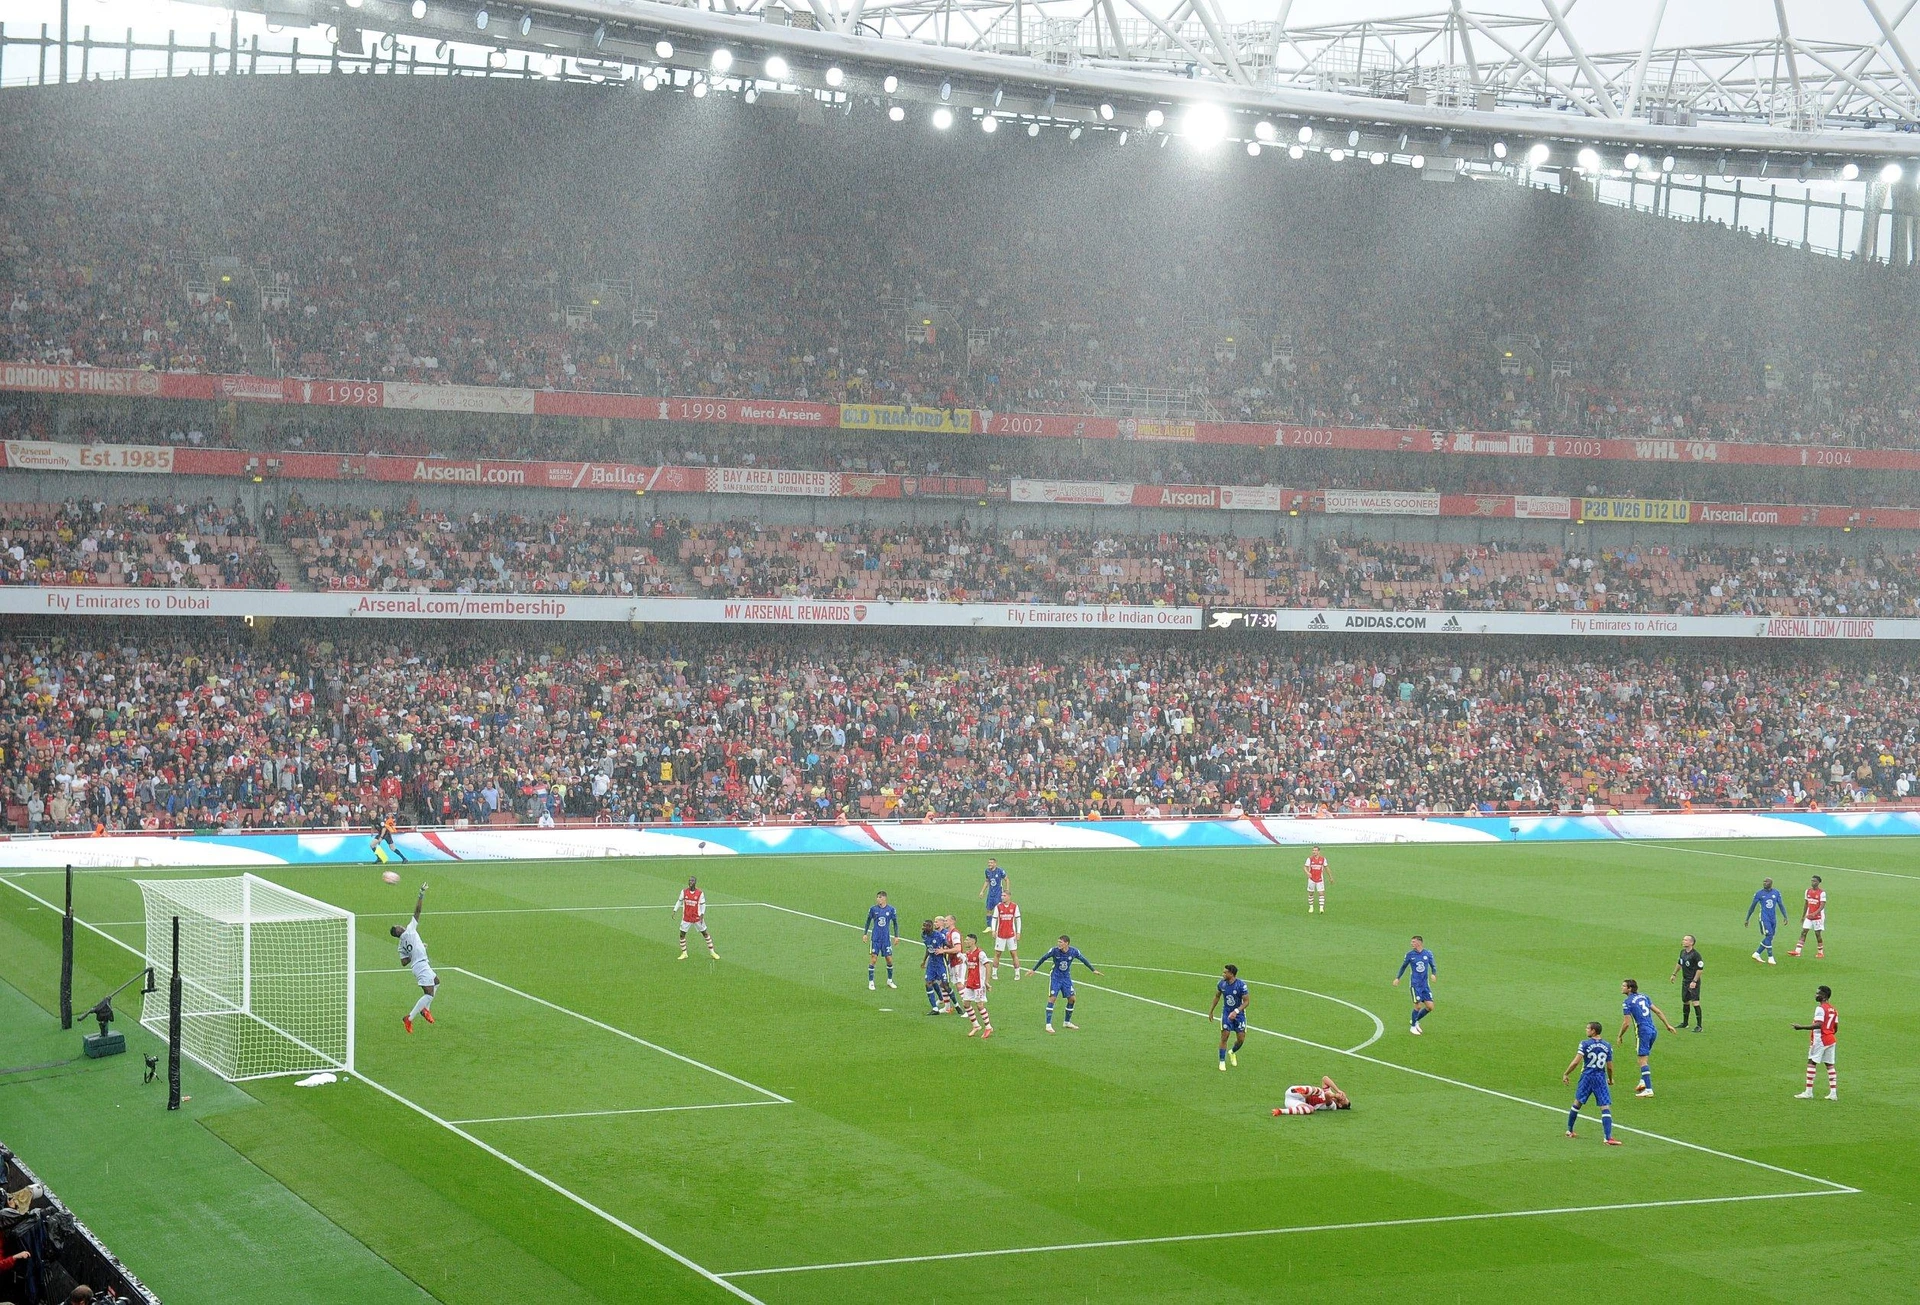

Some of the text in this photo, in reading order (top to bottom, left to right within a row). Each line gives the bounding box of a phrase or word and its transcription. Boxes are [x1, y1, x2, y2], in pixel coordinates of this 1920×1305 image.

[79, 371, 134, 391] FINEST
[327, 385, 378, 404] 1998
[681, 402, 728, 419] 1998
[740, 406, 822, 421] Merci Arsène
[843, 408, 870, 424] OLD
[874, 409, 943, 427] TRAFFORD
[1000, 417, 1043, 434] 2002
[1293, 430, 1333, 445] 2002
[20, 447, 51, 456] Arsenal
[1564, 441, 1601, 456] 2003
[1635, 441, 1717, 461] WHL '04
[19, 455, 69, 467] Community
[80, 448, 170, 468] Est. 1985
[1816, 451, 1852, 465] 2004
[413, 461, 525, 484] Arsenal.com
[591, 466, 645, 485] Dallas
[723, 470, 825, 486] BAY AREA GOONERS
[1057, 481, 1105, 497] Arsenal
[1160, 489, 1216, 506] Arsenal
[1327, 497, 1439, 509] SOUTH WALES GOONERS
[1584, 502, 1609, 517] P38
[1612, 502, 1640, 518] W26
[1645, 503, 1668, 519] D12
[1700, 506, 1778, 523] Arsenal.com
[47, 593, 210, 611] Fly Emirates to Dubai
[357, 596, 566, 618] Arsenal.com/membership
[724, 604, 850, 621] MY ARSENAL REWARDS
[1008, 608, 1193, 625] Fly Emirates to the Indian Ocean
[1243, 613, 1277, 628] 17:39
[1345, 616, 1426, 629] ADIDAS.COM
[1441, 624, 1463, 632] adidas
[1571, 618, 1677, 632] Fly Emirates to Africa
[1767, 619, 1874, 638] ARSENAL.COM/TOURS
[1765, 899, 1774, 908] 3
[877, 916, 887, 927] 3
[1059, 960, 1068, 971] 3
[1415, 961, 1426, 973] 3
[1639, 1000, 1650, 1017] 3
[1826, 1013, 1835, 1029] 7
[1586, 1051, 1608, 1069] 28
